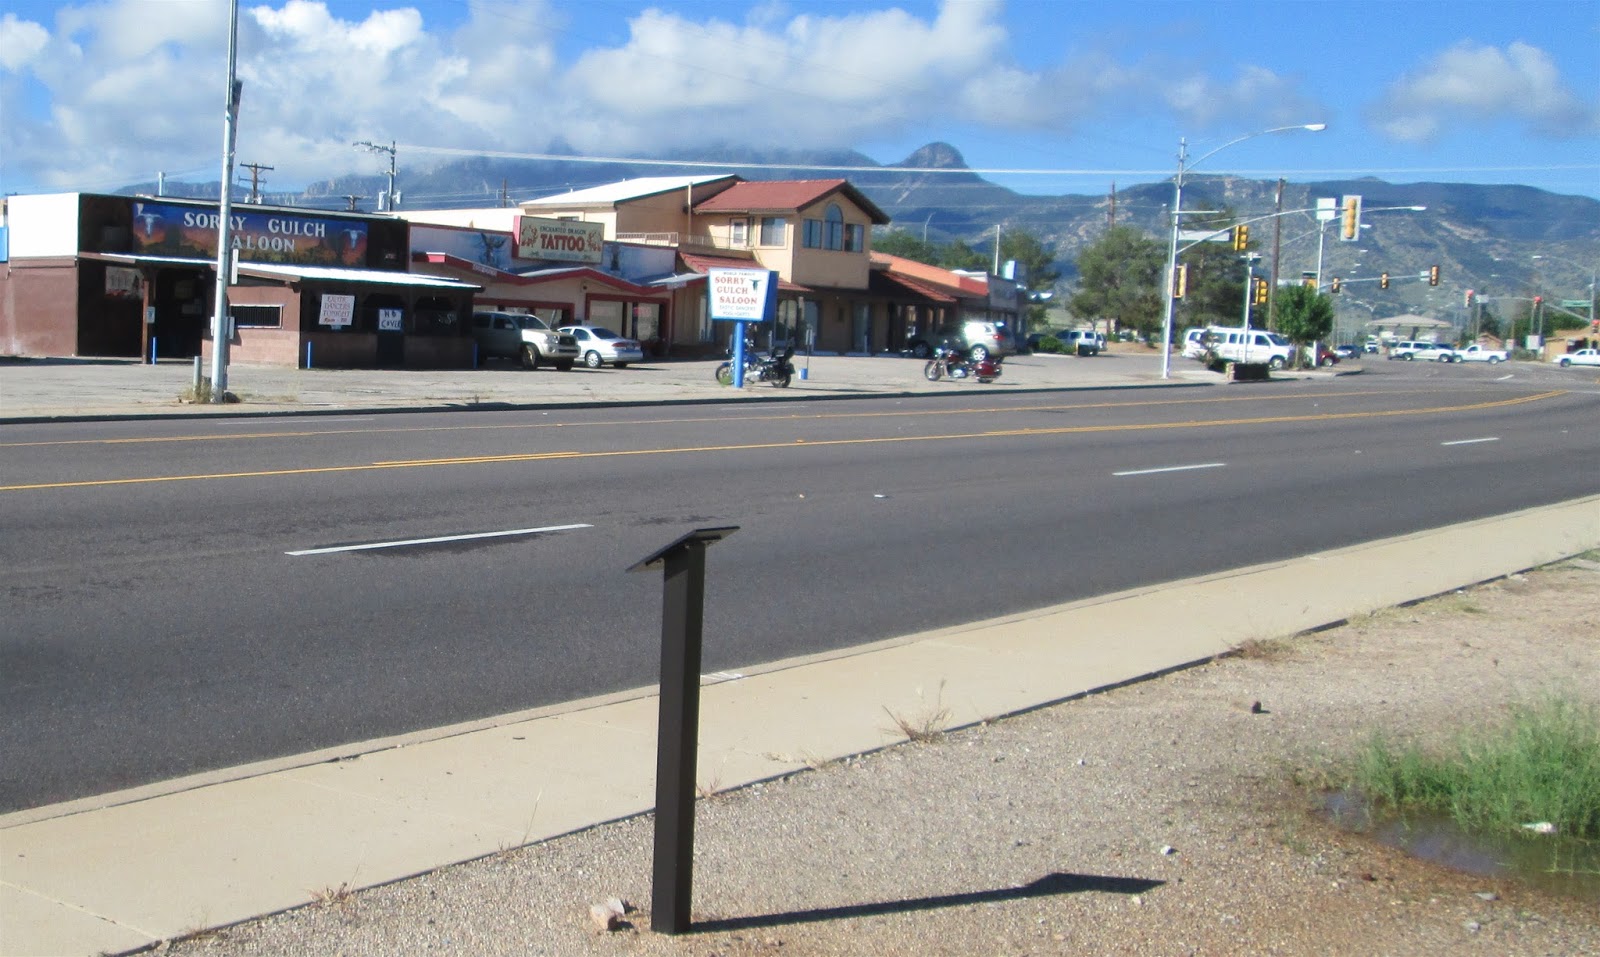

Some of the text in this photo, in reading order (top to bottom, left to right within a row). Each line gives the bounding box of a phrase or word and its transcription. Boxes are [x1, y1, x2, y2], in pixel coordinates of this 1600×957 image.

[268, 218, 326, 238] GULCH
[230, 235, 295, 252] ALOON
[540, 233, 585, 252] TATTOO
[715, 276, 746, 285] SORRY
[717, 286, 748, 295] GULCH
[719, 295, 758, 305] SALOON
[384, 310, 397, 318] NO
